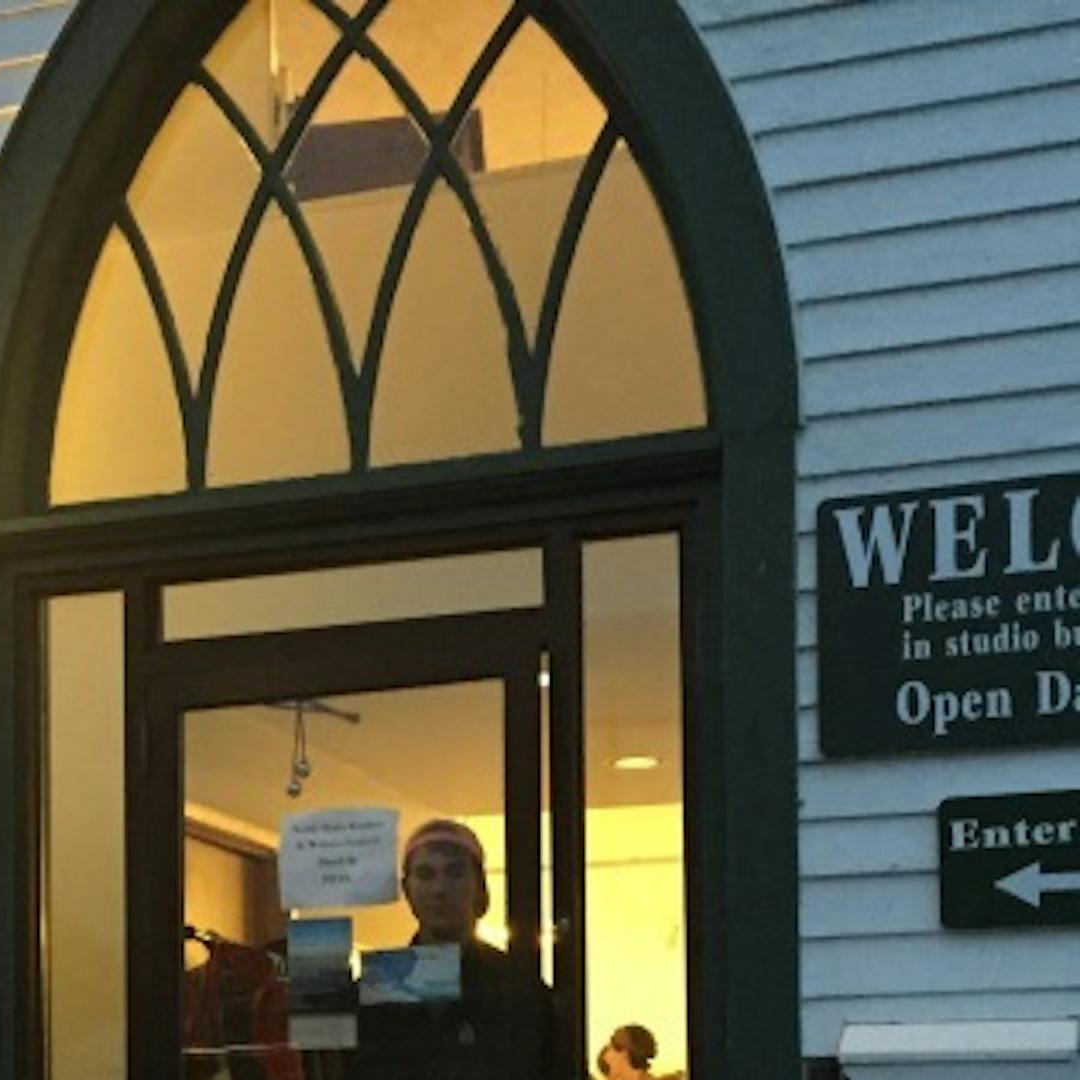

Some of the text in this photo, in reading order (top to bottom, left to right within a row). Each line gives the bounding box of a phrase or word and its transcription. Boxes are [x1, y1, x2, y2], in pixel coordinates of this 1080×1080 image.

[832, 488, 1080, 588] WEL
[902, 591, 999, 624] Please
[902, 629, 931, 660] in
[945, 621, 1040, 656] studio
[896, 680, 1013, 736] Open
[949, 818, 1079, 851] Enter
